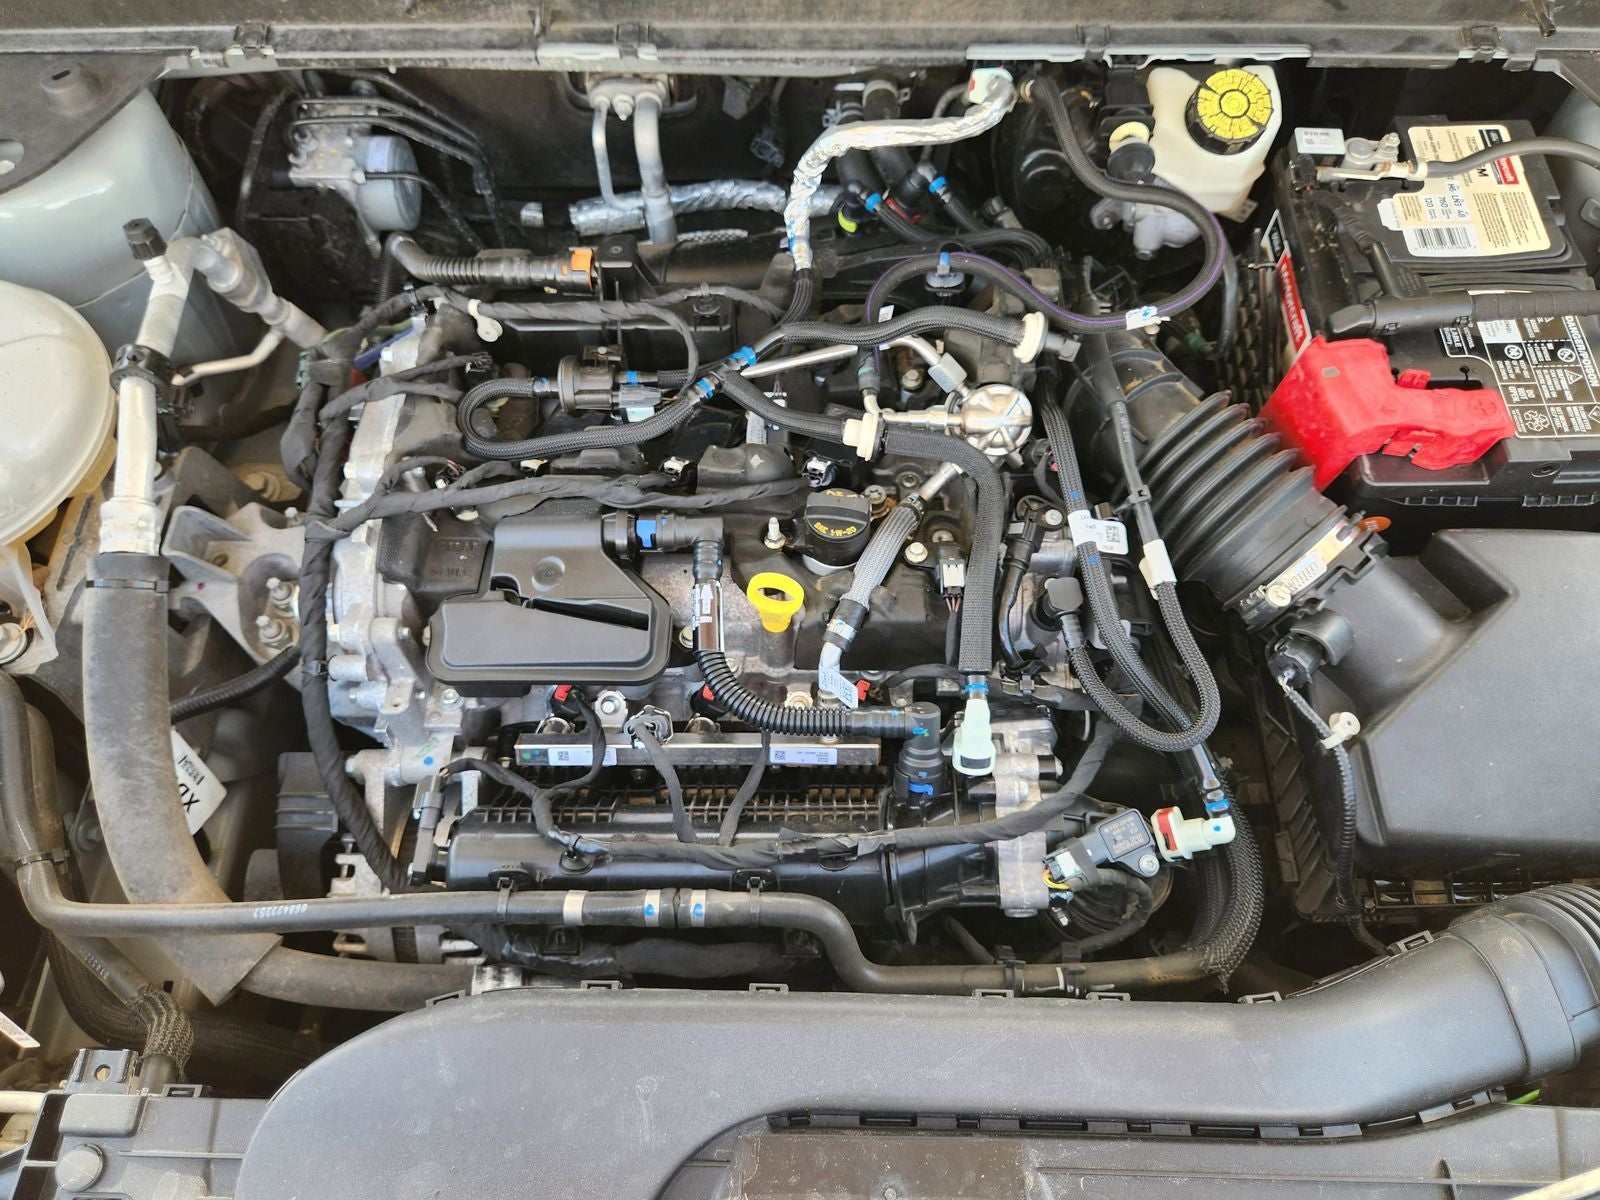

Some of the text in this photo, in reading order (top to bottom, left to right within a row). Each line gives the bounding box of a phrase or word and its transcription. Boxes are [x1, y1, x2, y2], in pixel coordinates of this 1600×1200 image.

[1424, 198, 1434, 208] 120
[1438, 196, 1449, 208] 760
[1565, 316, 1599, 387] DANGER/POISON
[1508, 386, 1519, 403] OPEN.
[1518, 388, 1527, 400] NOT
[1526, 390, 1535, 398] DO
